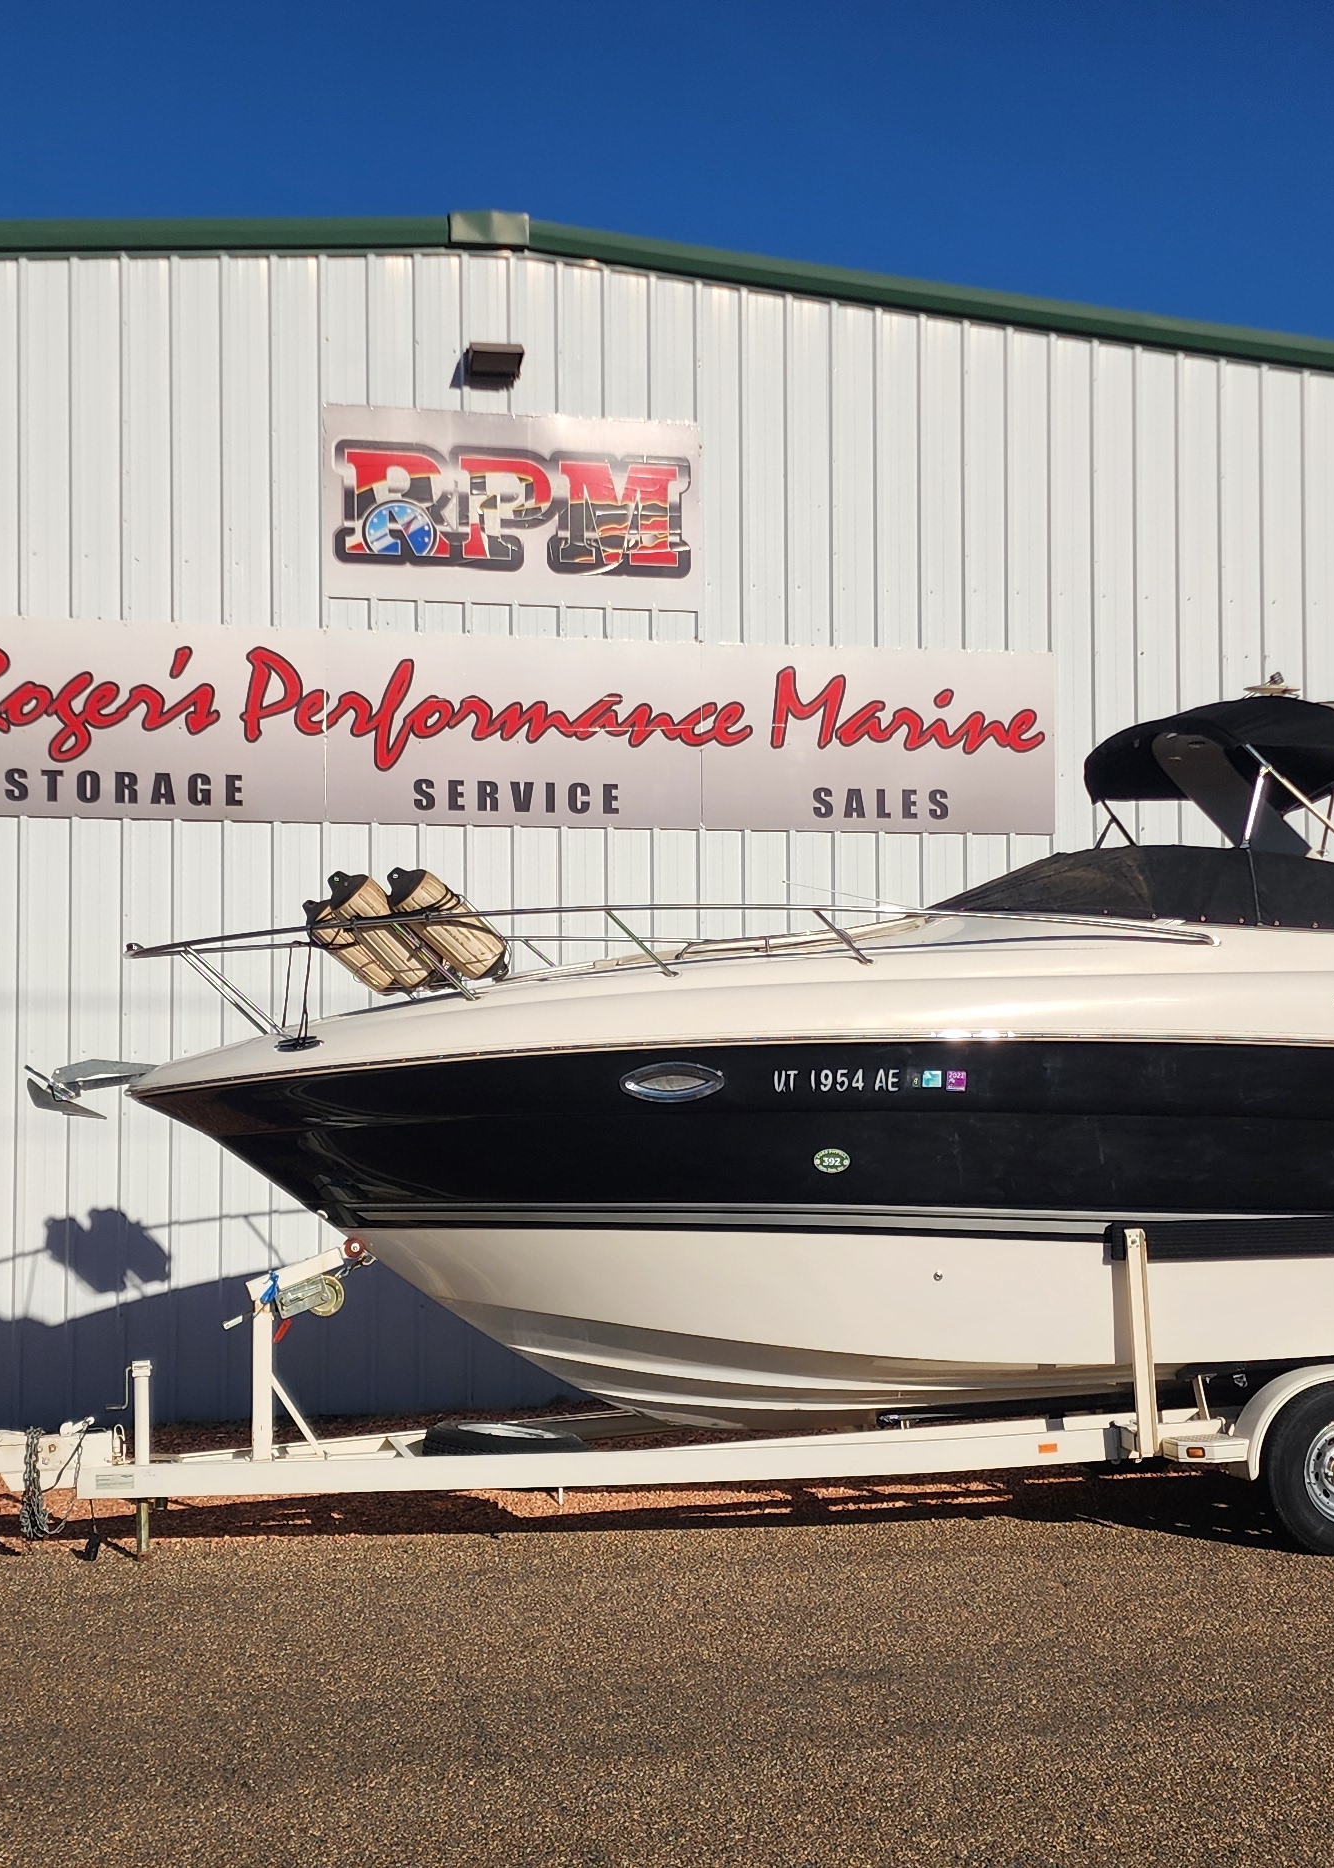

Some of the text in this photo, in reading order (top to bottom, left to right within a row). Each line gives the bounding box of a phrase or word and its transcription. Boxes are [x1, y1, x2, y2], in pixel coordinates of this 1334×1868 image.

[243, 645, 753, 771] Performance
[770, 665, 1045, 754] Marine
[4, 767, 244, 807] STORAGE
[413, 778, 620, 814] SERVICE
[812, 787, 949, 819] SALES
[773, 1068, 900, 1093] UT 1954 AE
[822, 1157, 841, 1166] 392
